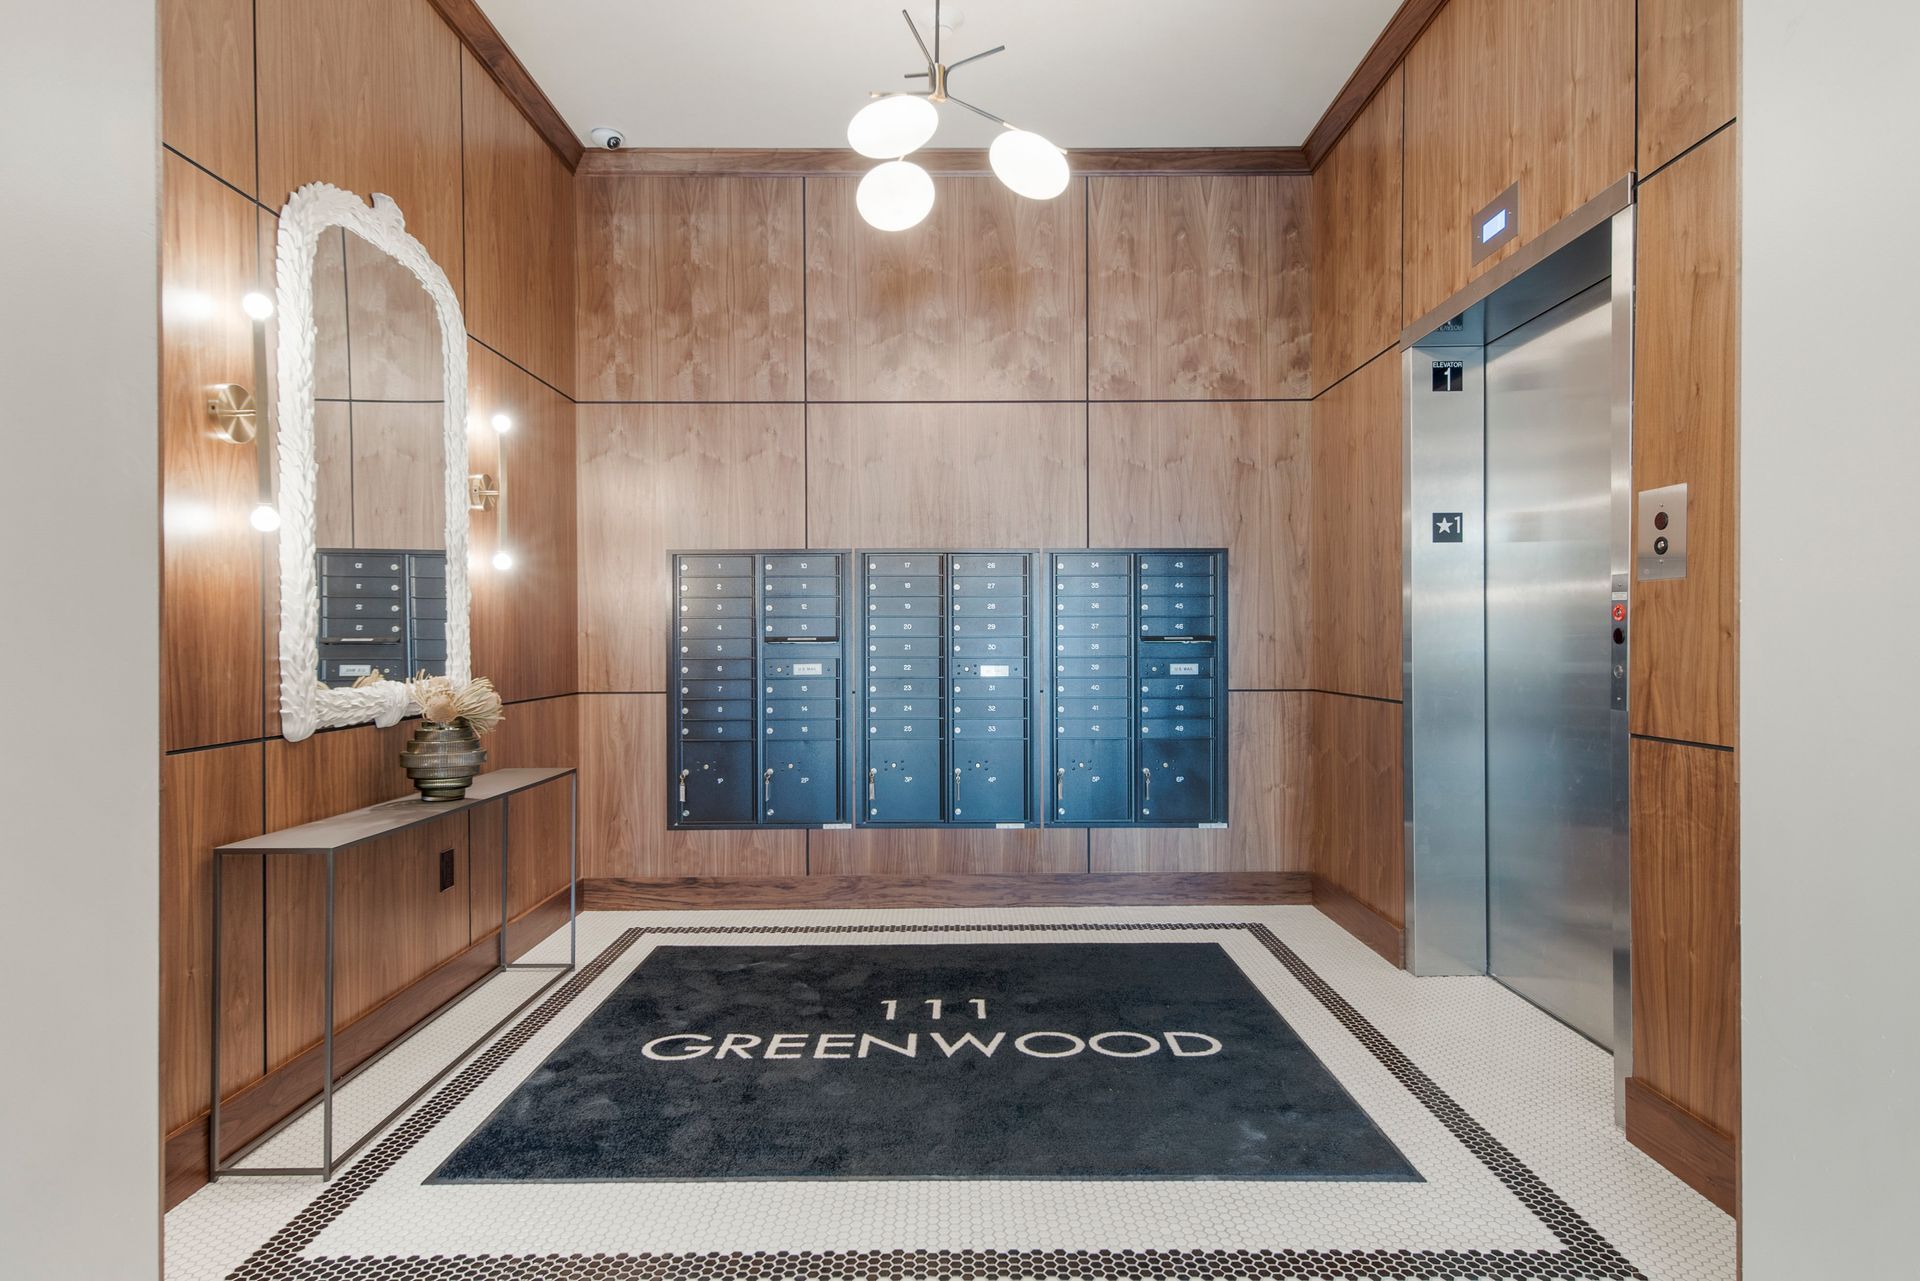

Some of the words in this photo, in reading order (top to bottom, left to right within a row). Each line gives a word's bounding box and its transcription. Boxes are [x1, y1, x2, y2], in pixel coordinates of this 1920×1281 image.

[1444, 367, 1451, 391] 1
[1454, 516, 1461, 534] 1
[880, 999, 987, 1020] 111
[641, 1031, 1222, 1061] GREENWOOD
